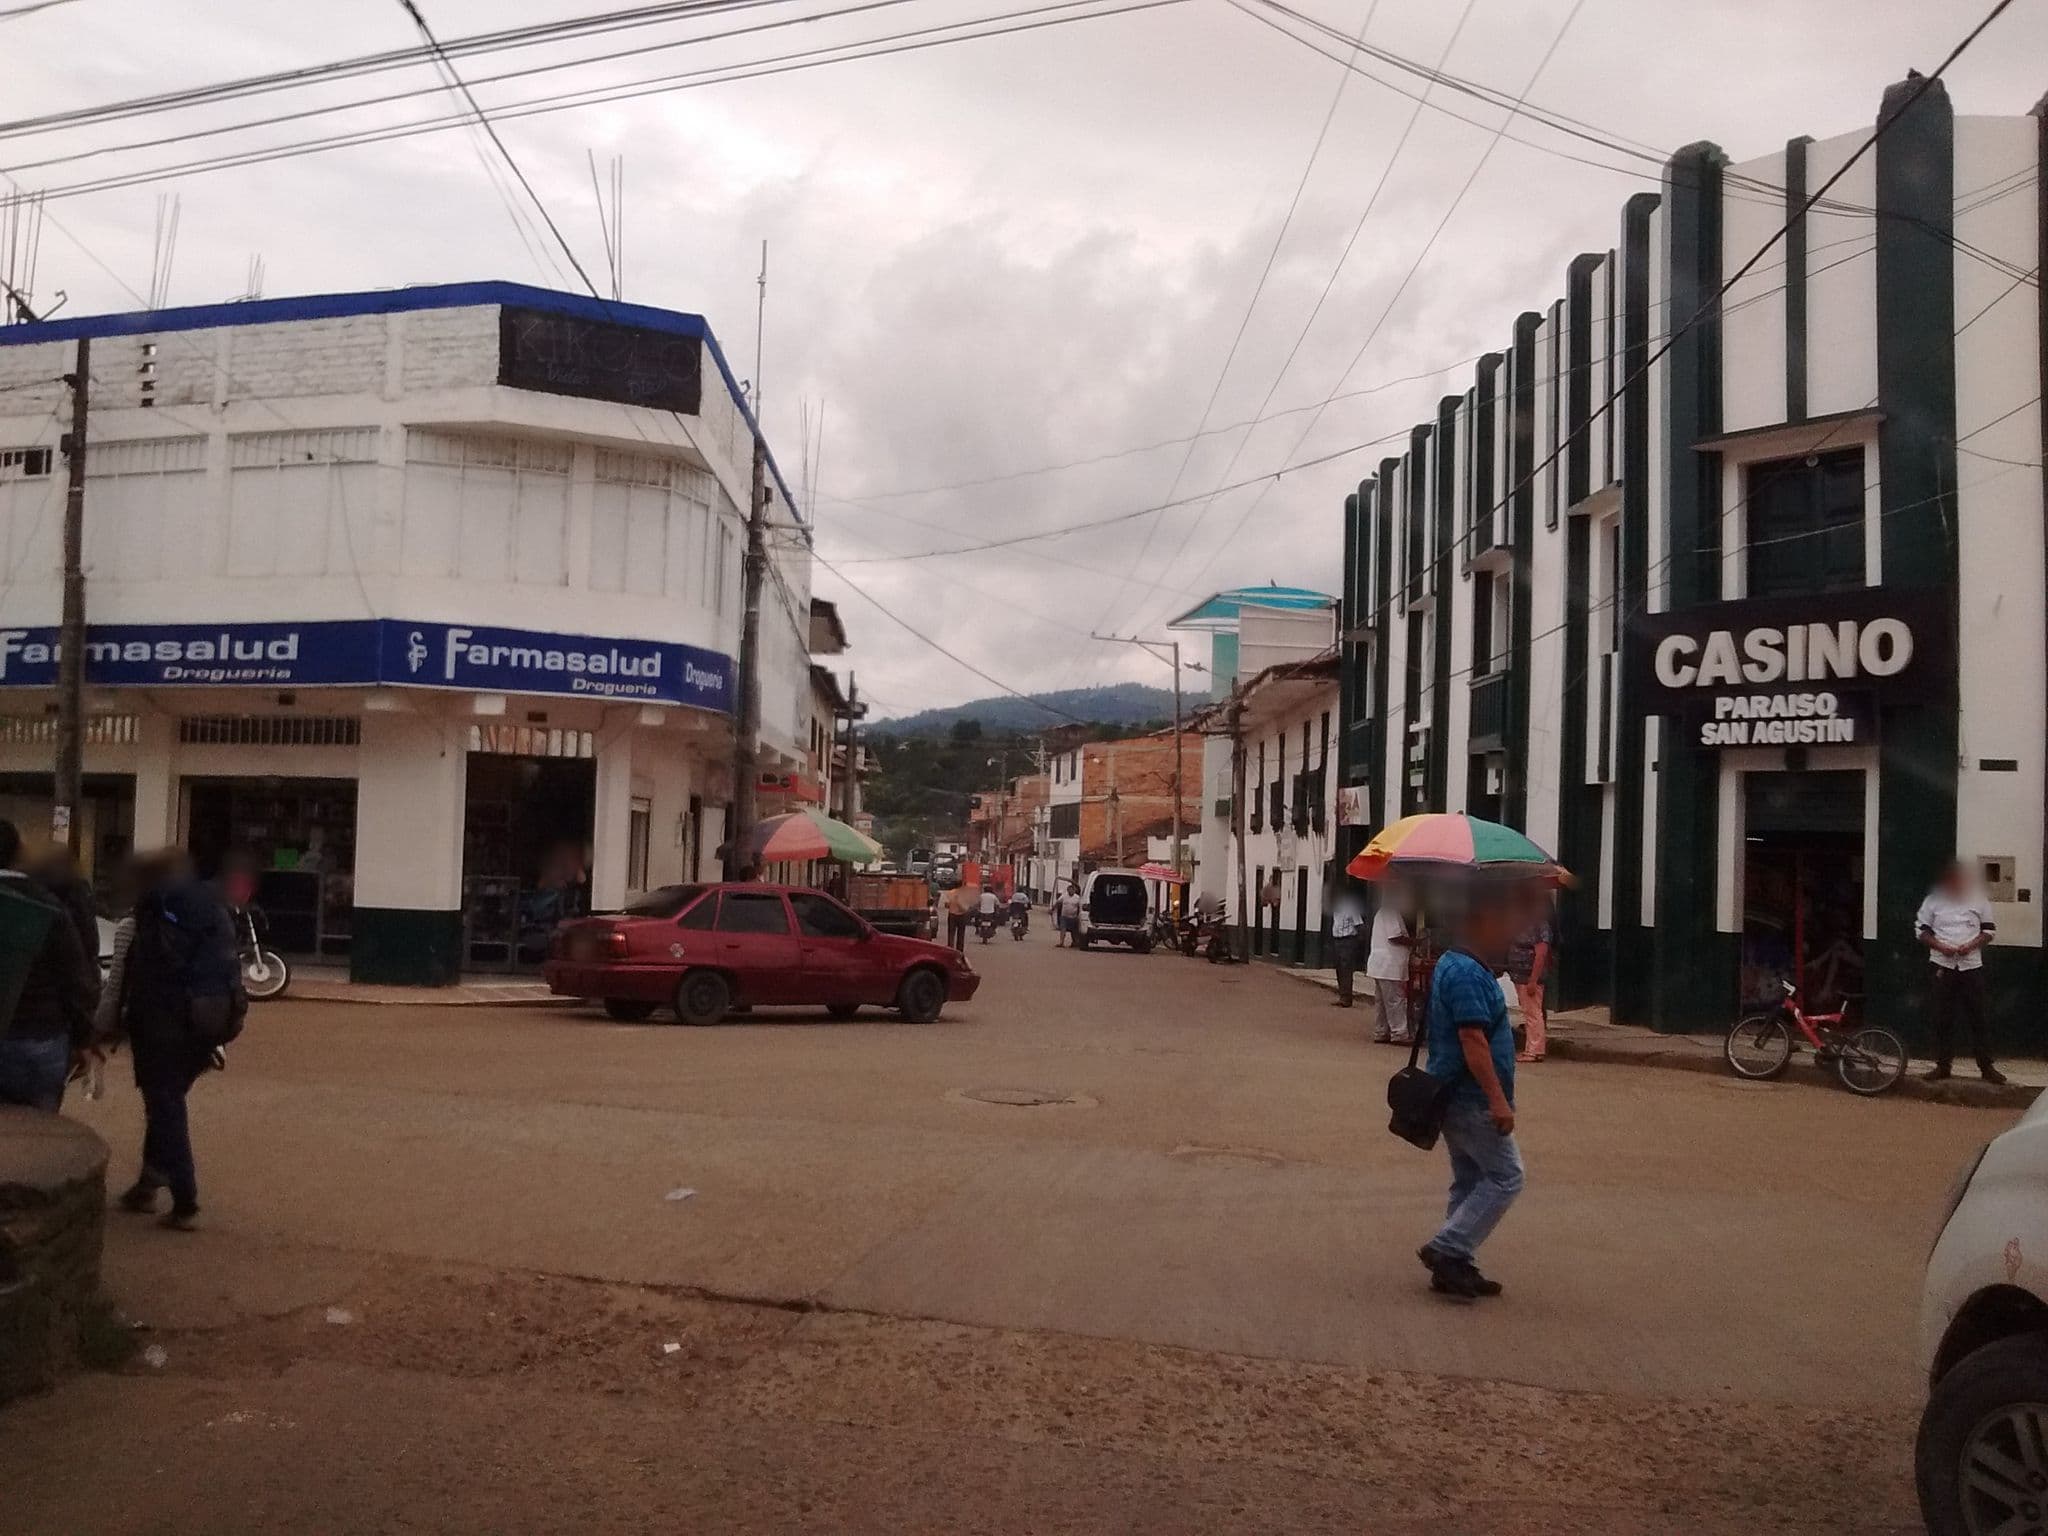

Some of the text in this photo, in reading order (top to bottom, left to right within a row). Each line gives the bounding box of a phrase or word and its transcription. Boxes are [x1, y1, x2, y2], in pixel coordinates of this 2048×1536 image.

[444, 628, 661, 680] Farmasalud
[1655, 618, 1914, 688] CASINO
[1715, 692, 1838, 719] PARAISO
[1700, 722, 1748, 745] SAN
